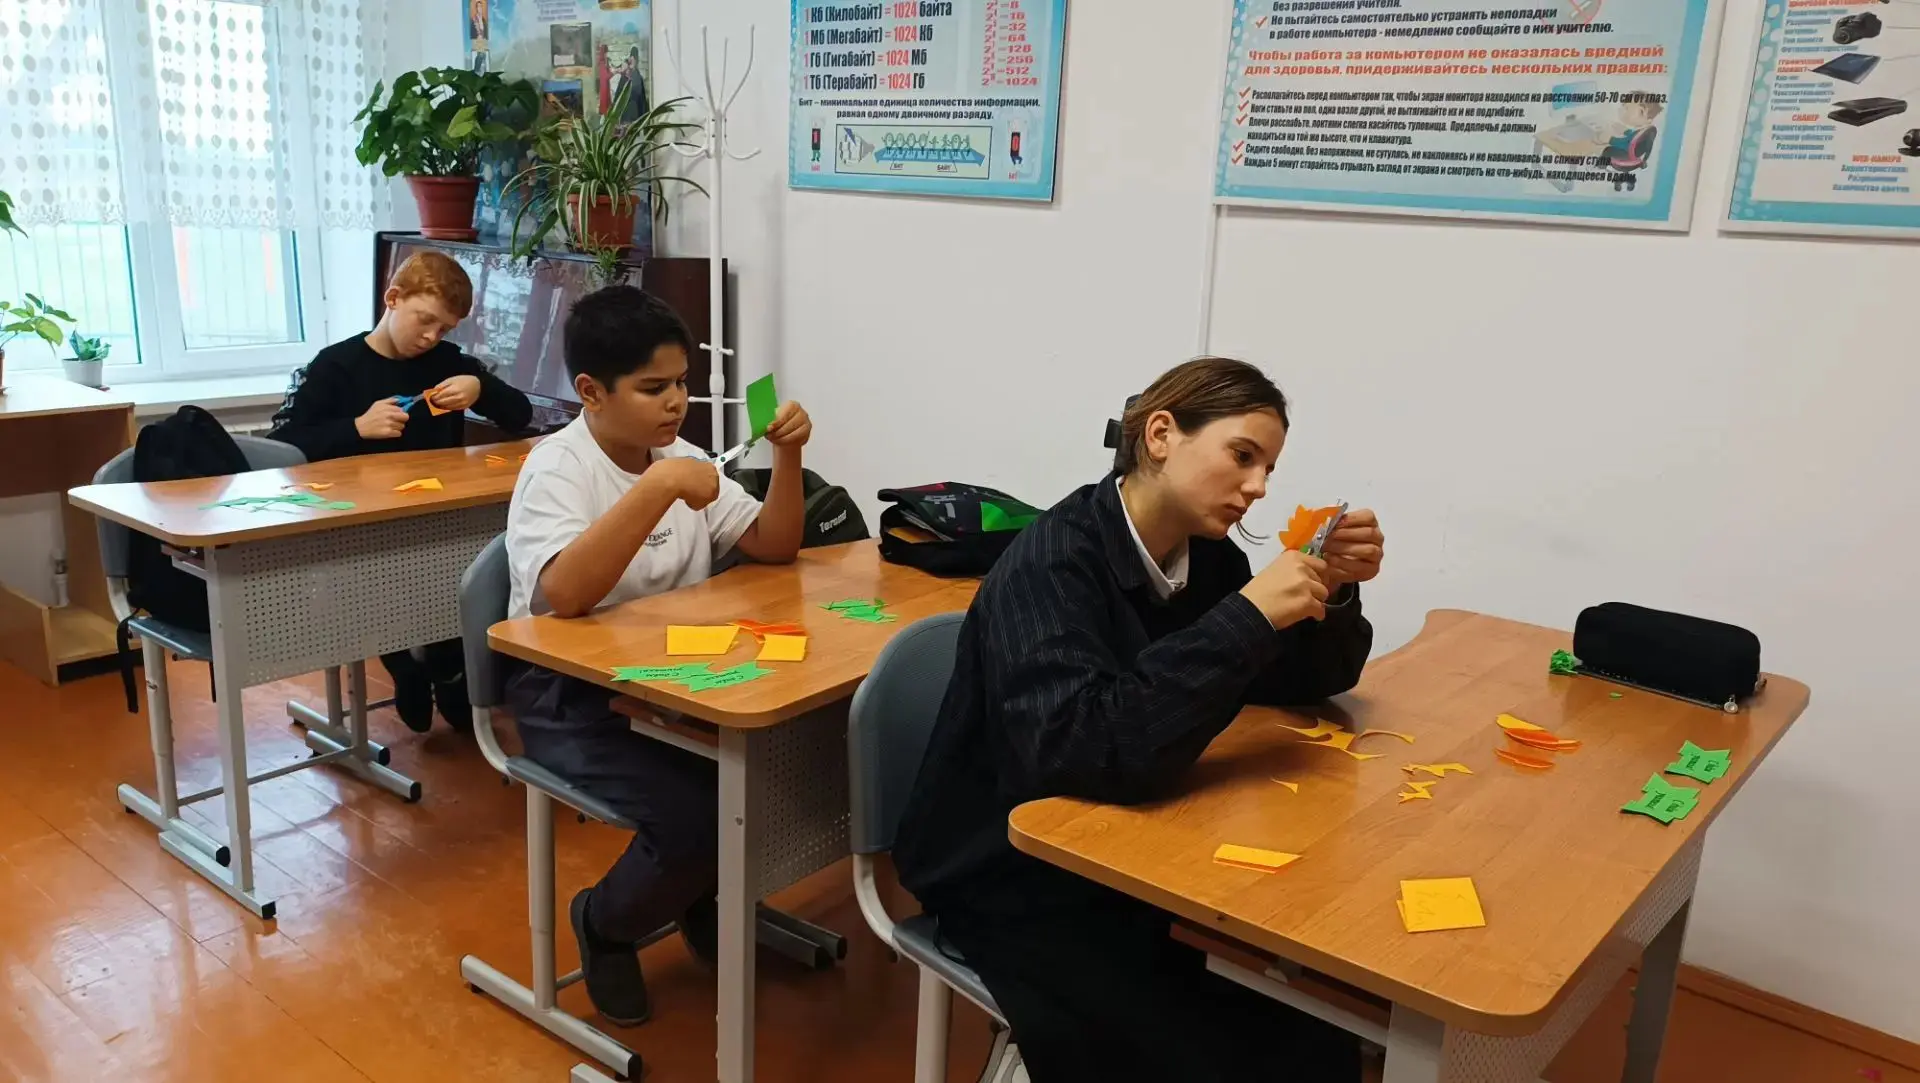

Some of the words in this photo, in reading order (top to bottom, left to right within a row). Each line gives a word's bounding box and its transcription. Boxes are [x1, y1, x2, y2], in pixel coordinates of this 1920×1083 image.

[811, 7, 823, 22] Кб
[825, 4, 882, 22] (Килобайт)
[894, 1, 917, 18] 1024
[919, 0, 952, 17] байта
[1273, 1, 1289, 12] без
[1292, 1, 1354, 12] разрешения
[1357, 0, 1402, 9] учителя.
[1271, 15, 1283, 25] Не
[1285, 14, 1339, 25] пытайтесь
[1341, 12, 1429, 24] самостоятельно
[1431, 11, 1488, 22] устранять
[1490, 8, 1557, 20] неполадки
[811, 30, 824, 45] Мб
[827, 27, 883, 44] (Мегабайт)
[894, 25, 917, 42] 1024
[920, 24, 933, 41] Кб
[1277, 29, 1310, 40] работе
[1312, 28, 1377, 39] компьютера
[1385, 26, 1454, 38] немедленно
[1456, 24, 1520, 36] сообщайте
[1533, 24, 1554, 34] них
[1556, 22, 1613, 34] учителю.
[811, 52, 821, 67] Гб
[823, 50, 875, 67] (Гигабайт)
[886, 50, 909, 65] 1024
[911, 49, 927, 65] Мб
[1249, 50, 1292, 60] Чтобы
[1294, 50, 1343, 61] работа
[1346, 51, 1362, 60] за
[1468, 49, 1488, 59] не
[1491, 48, 1581, 58] оказалась
[1584, 45, 1664, 59] вредной
[1245, 66, 1270, 75] для
[1346, 63, 1487, 75] придерживайтесь
[1491, 63, 1592, 74] нескольких
[1595, 63, 1668, 75] правил:
[810, 75, 821, 90] Тб
[823, 73, 877, 91] (Терабайт)
[887, 74, 910, 89] 1024
[913, 73, 925, 89] Гб
[798, 97, 813, 107] Бит
[820, 98, 878, 107] минимальная
[879, 98, 917, 108] единица
[918, 98, 973, 107] количества
[1252, 89, 1305, 100] Располагайтесь
[1306, 91, 1328, 101] перед
[1329, 92, 1380, 102] компьютером
[1396, 90, 1420, 100] чтобы
[1421, 92, 1444, 102] экран
[1445, 93, 1484, 103] монитора
[1485, 93, 1530, 103] находился
[1531, 93, 1542, 102] на
[1543, 93, 1594, 103] расстоянии
[1595, 92, 1619, 103] 50-70
[836, 110, 866, 119] равная
[867, 110, 900, 120] одному
[901, 110, 951, 120] двоичному
[952, 110, 994, 120] разряду.
[1250, 104, 1266, 113] Ноги
[1266, 105, 1293, 114] ставьте
[1293, 106, 1302, 114] на
[1387, 107, 1397, 116] не
[1397, 106, 1448, 117] вытягивайте
[1465, 108, 1475, 117] не
[1249, 117, 1270, 127] Плечи
[1343, 121, 1367, 129] слегка
[1368, 119, 1407, 130] касайтесь
[1450, 121, 1500, 132] Предплечья
[1500, 123, 1537, 133] должны
[1247, 132, 1286, 141] находиться
[1287, 133, 1296, 142] на
[1297, 132, 1308, 142] той
